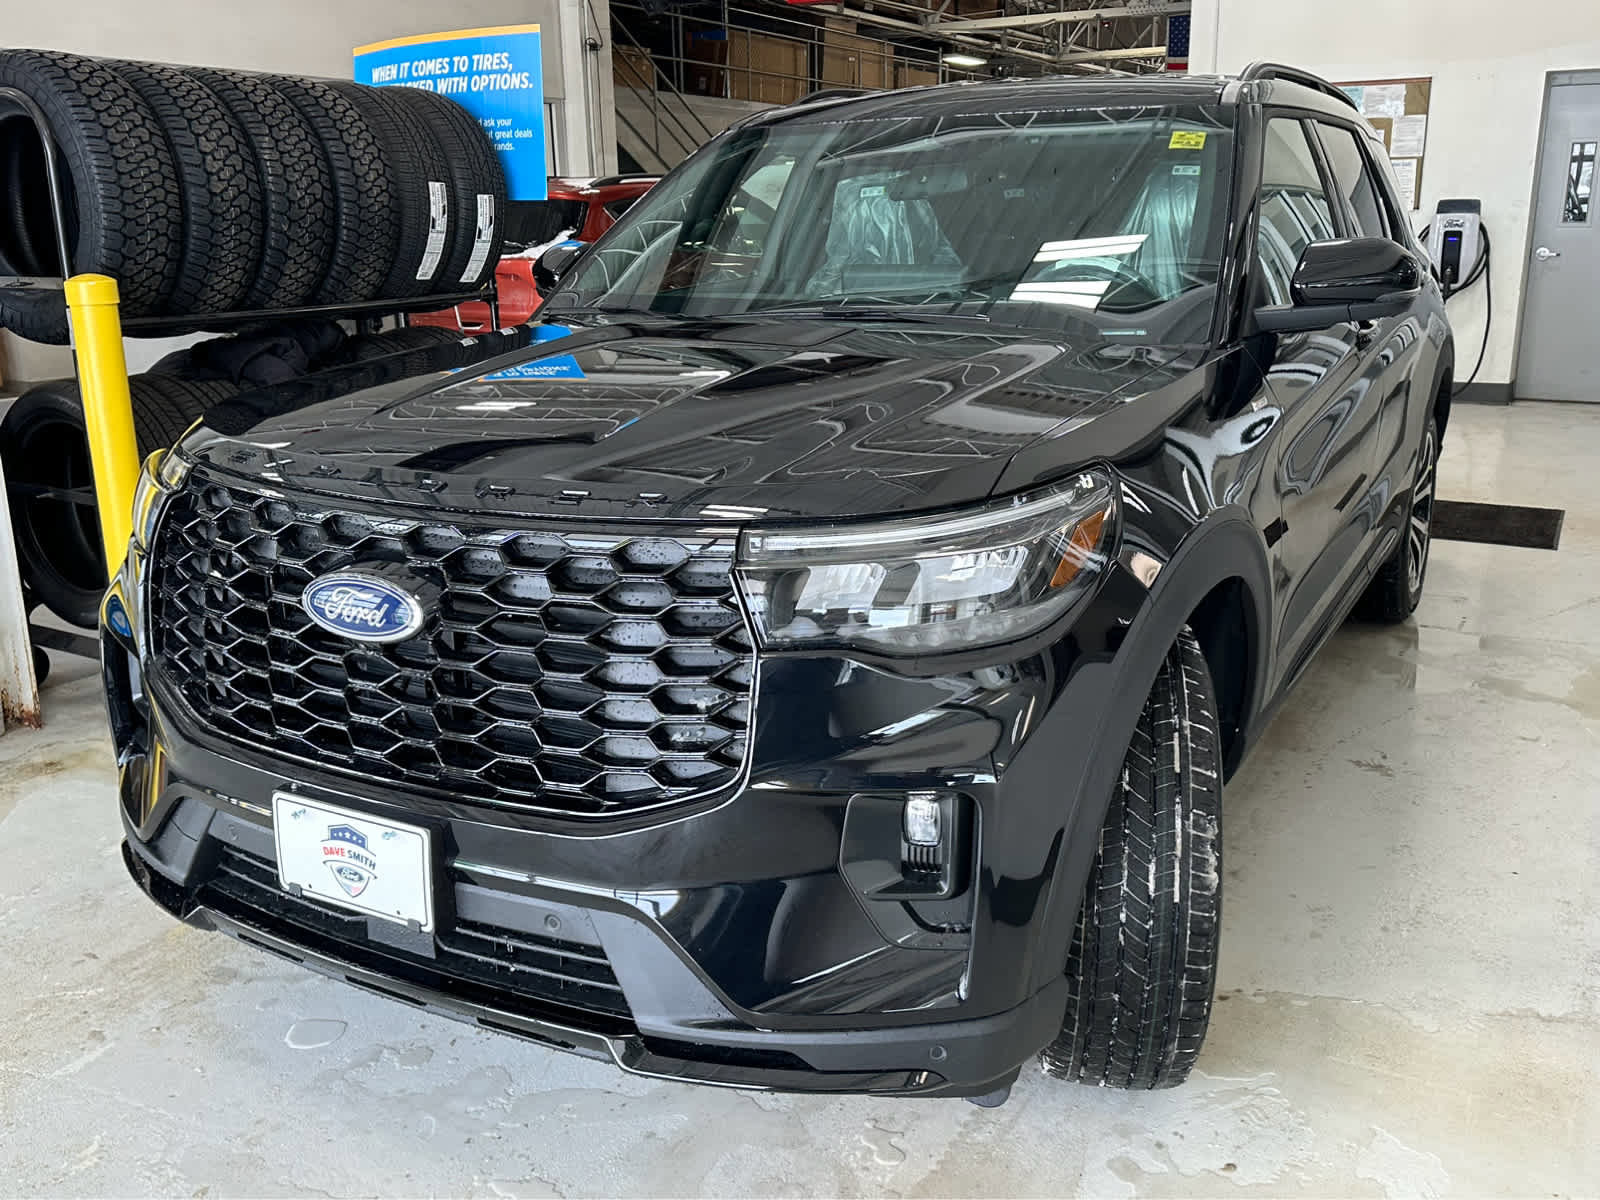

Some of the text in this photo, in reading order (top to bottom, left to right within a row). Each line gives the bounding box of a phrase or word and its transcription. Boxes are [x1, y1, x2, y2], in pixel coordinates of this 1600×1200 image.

[372, 52, 513, 83] WHEN IT COMES TO TIRES,
[436, 77, 468, 95] WITH
[470, 72, 533, 92] OPTIONS.
[483, 117, 495, 128] ask
[496, 118, 512, 129] your
[495, 129, 513, 141] great
[514, 127, 533, 139] deals
[494, 141, 515, 151] rands.
[323, 586, 390, 628] Ford
[322, 846, 377, 871] DAVE SMITH
